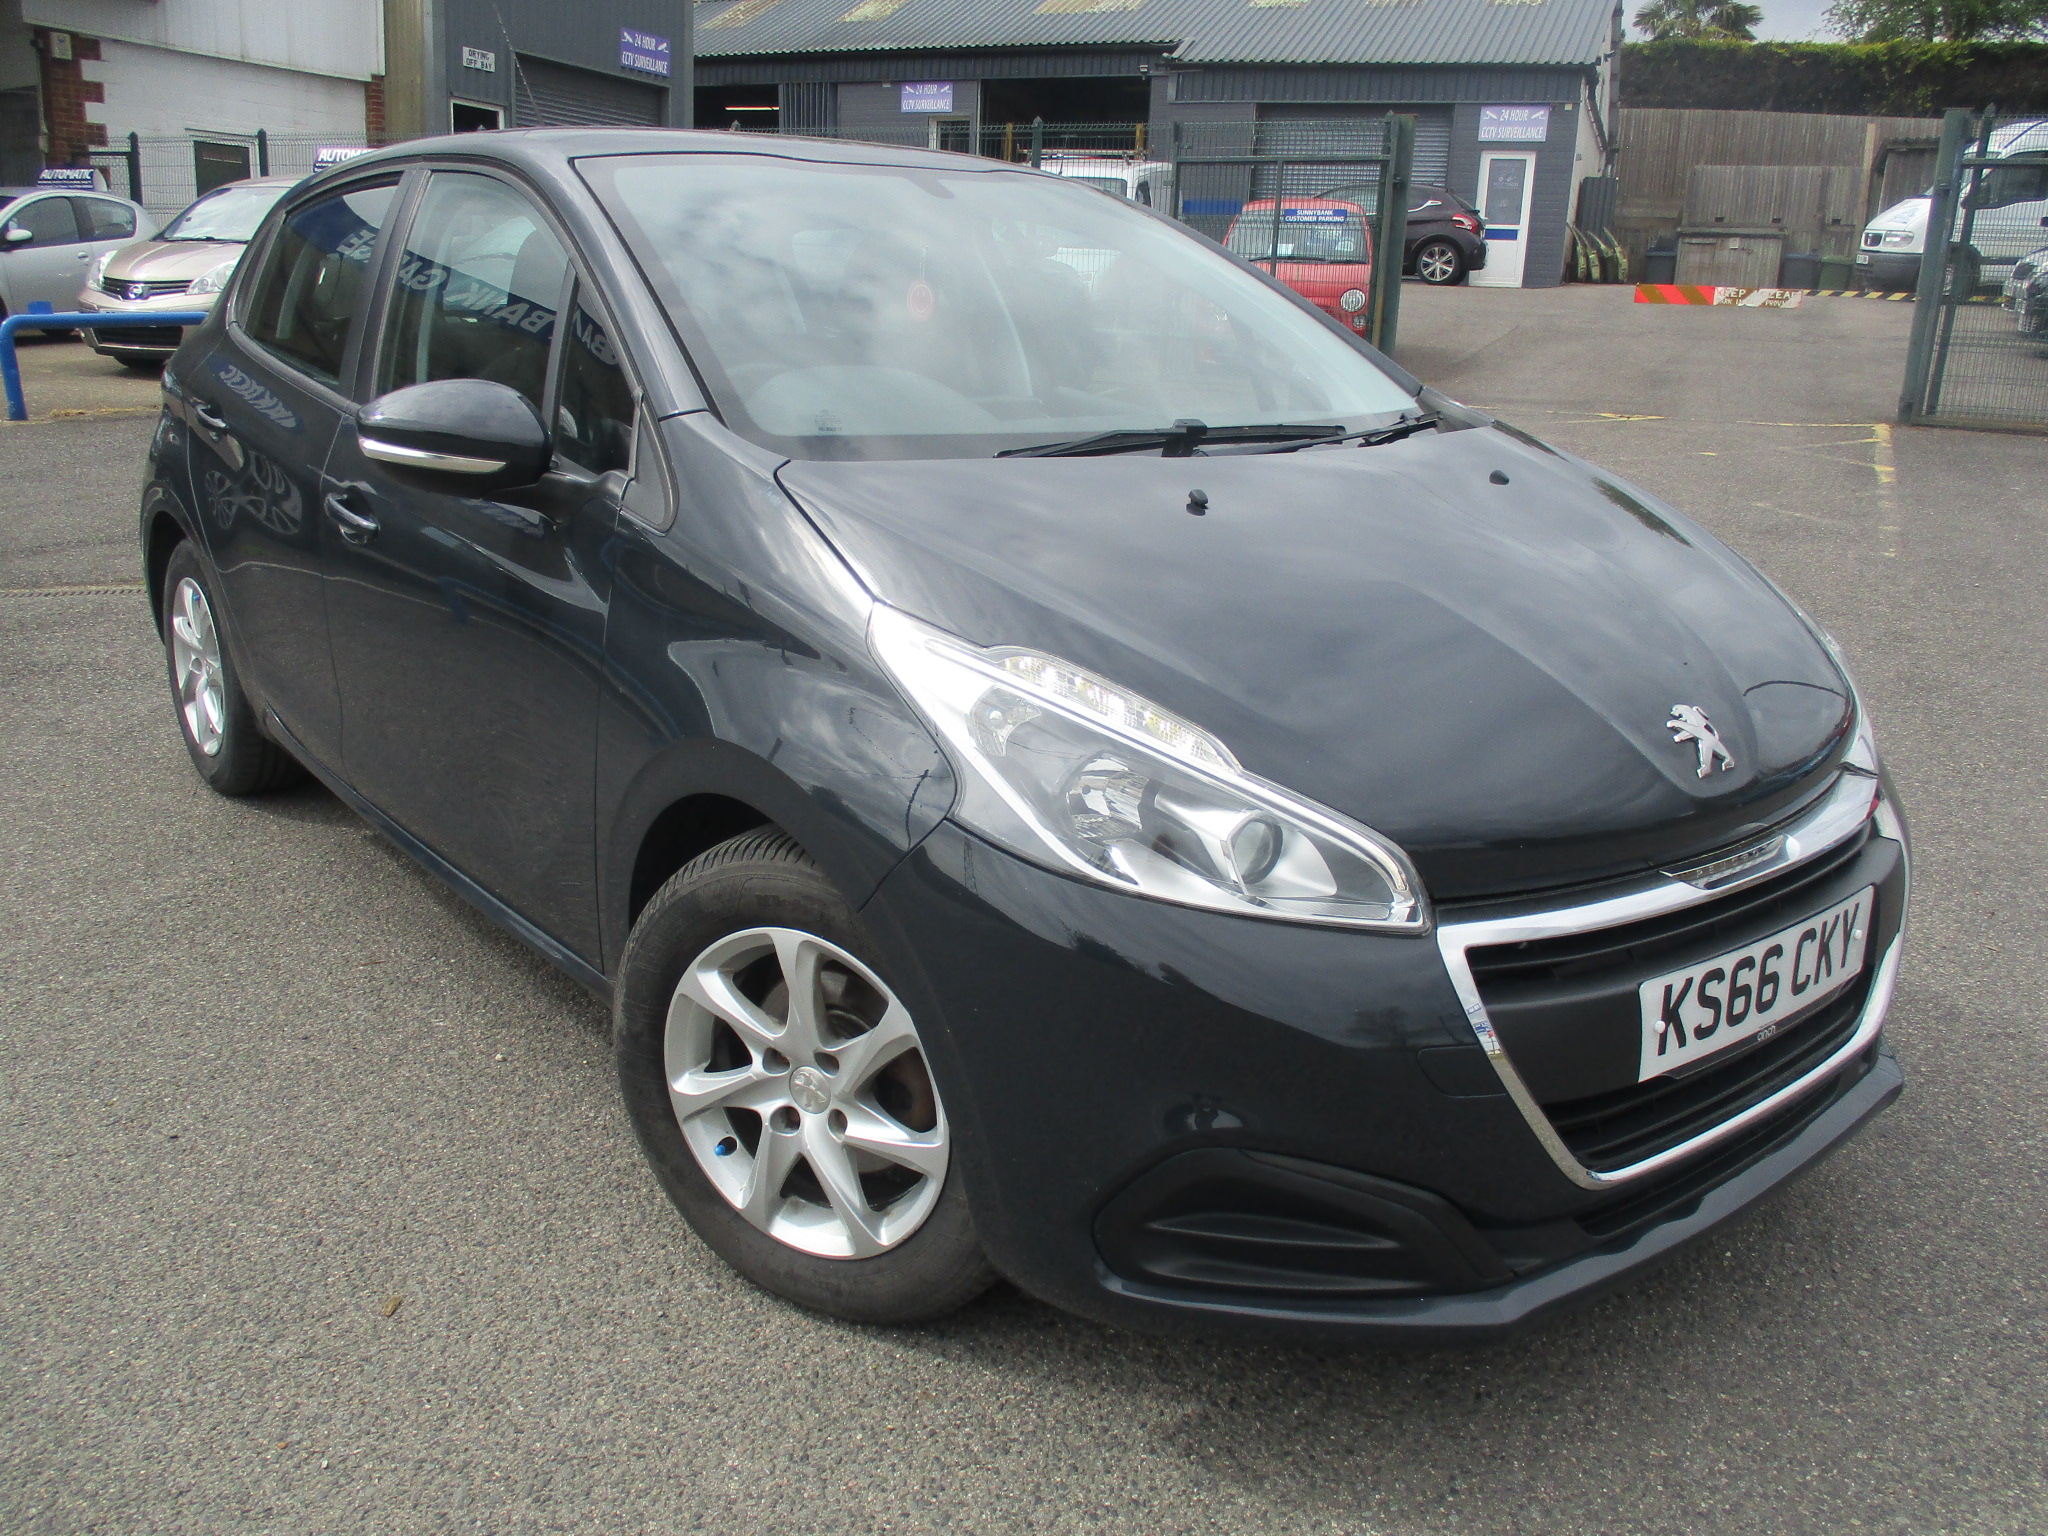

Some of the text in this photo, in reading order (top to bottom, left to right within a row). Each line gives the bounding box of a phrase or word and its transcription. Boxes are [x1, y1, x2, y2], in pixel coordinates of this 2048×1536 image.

[634, 33, 656, 51] 24 HOUR
[468, 49, 490, 60] DRYING
[466, 58, 492, 70] OFF BAY
[622, 51, 668, 74] CCTV SURVEILLANCE
[923, 84, 938, 95] HOUR
[1500, 109, 1529, 121] 24 HOUR
[1481, 126, 1544, 139] CCTV SURVEILLANCE
[317, 148, 374, 162] AUTOM
[39, 168, 95, 180] AUTOMATIC
[1657, 902, 1861, 1057] KS66 CKY
